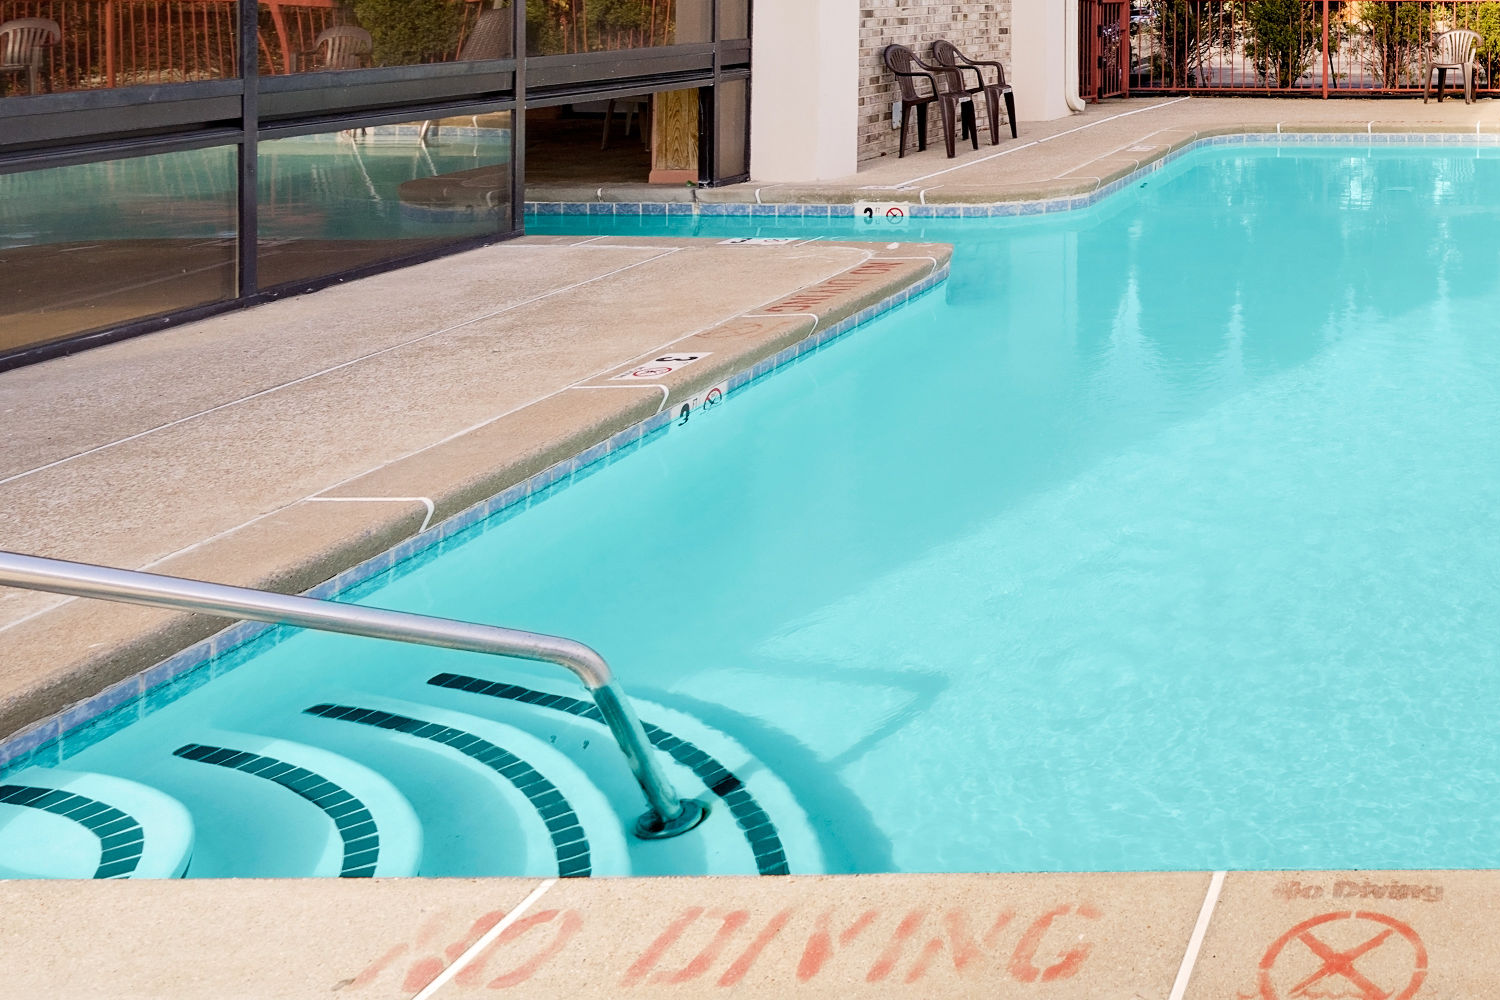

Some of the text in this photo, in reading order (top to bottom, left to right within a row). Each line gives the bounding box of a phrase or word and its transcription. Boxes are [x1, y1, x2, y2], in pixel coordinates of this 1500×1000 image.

[1332, 880, 1444, 903] Diving
[350, 903, 1105, 992] NO DIVING
